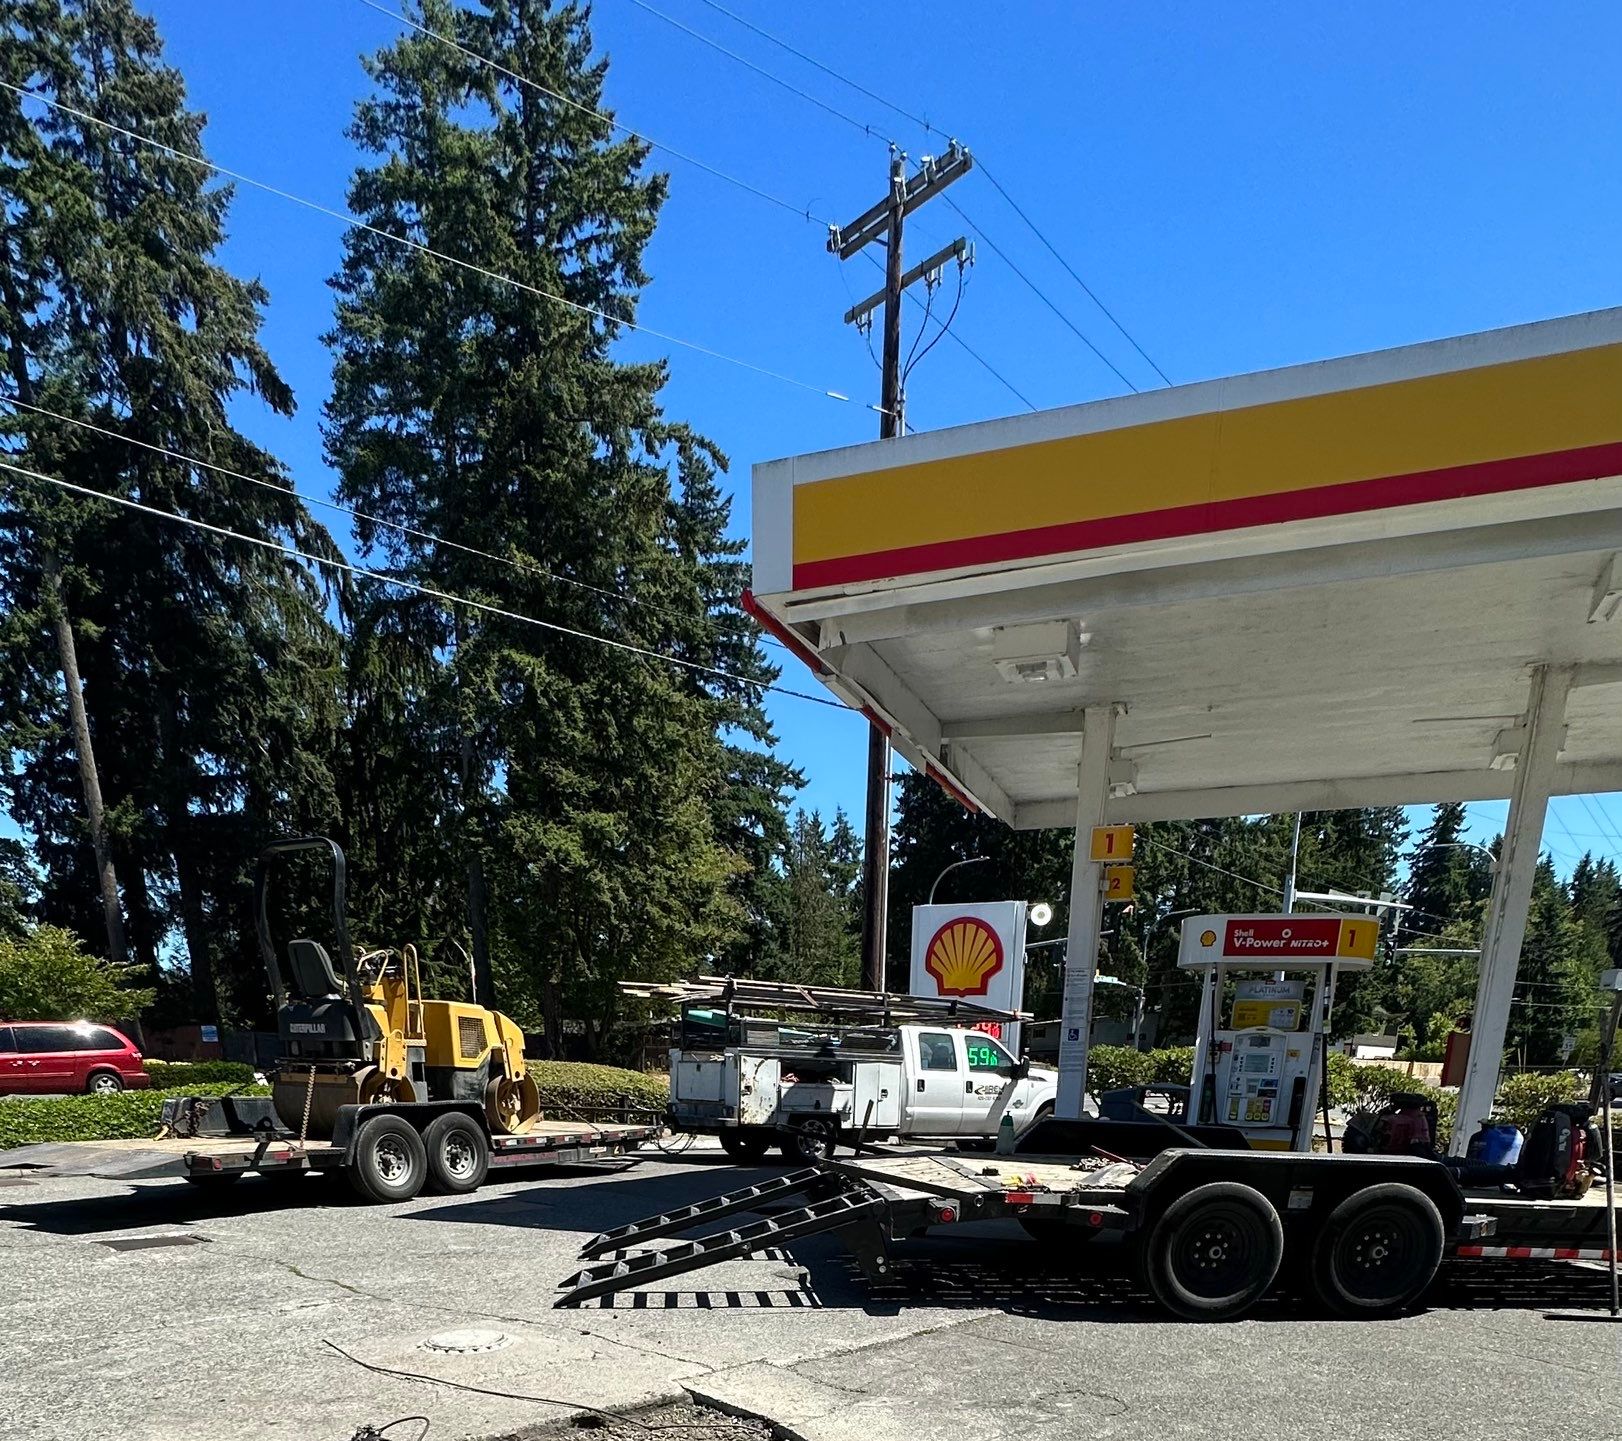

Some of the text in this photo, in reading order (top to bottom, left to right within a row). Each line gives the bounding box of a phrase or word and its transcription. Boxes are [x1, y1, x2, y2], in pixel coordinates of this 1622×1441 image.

[1105, 833, 1114, 854] 1
[1111, 877, 1121, 890] 2
[1233, 928, 1254, 937] Shell
[1349, 929, 1357, 948] 1
[1233, 937, 1285, 948] V-Power
[290, 1023, 326, 1034] CATERPILLAR
